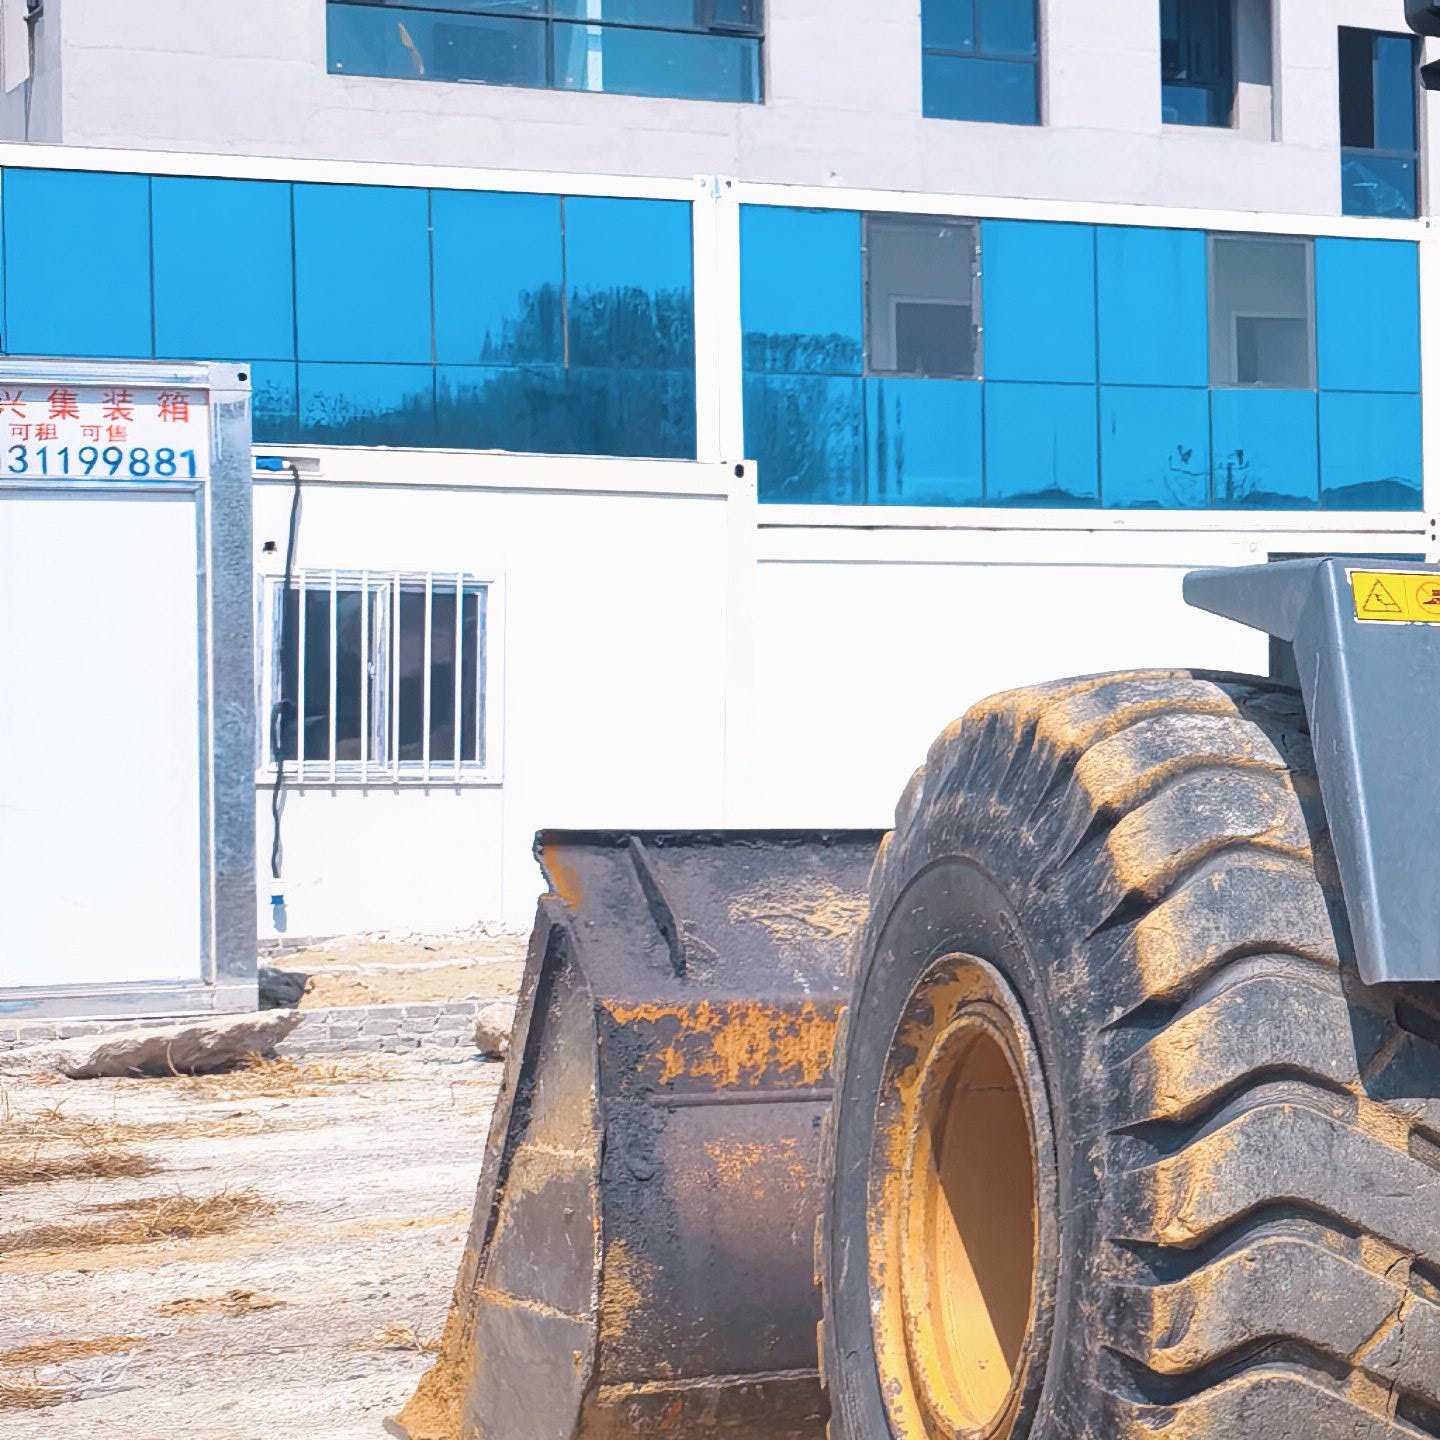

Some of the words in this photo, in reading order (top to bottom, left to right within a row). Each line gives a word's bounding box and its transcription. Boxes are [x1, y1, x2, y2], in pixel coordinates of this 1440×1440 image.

[9, 423, 58, 442] 可租
[80, 423, 129, 443] 可售
[0, 444, 197, 478] 31199881
